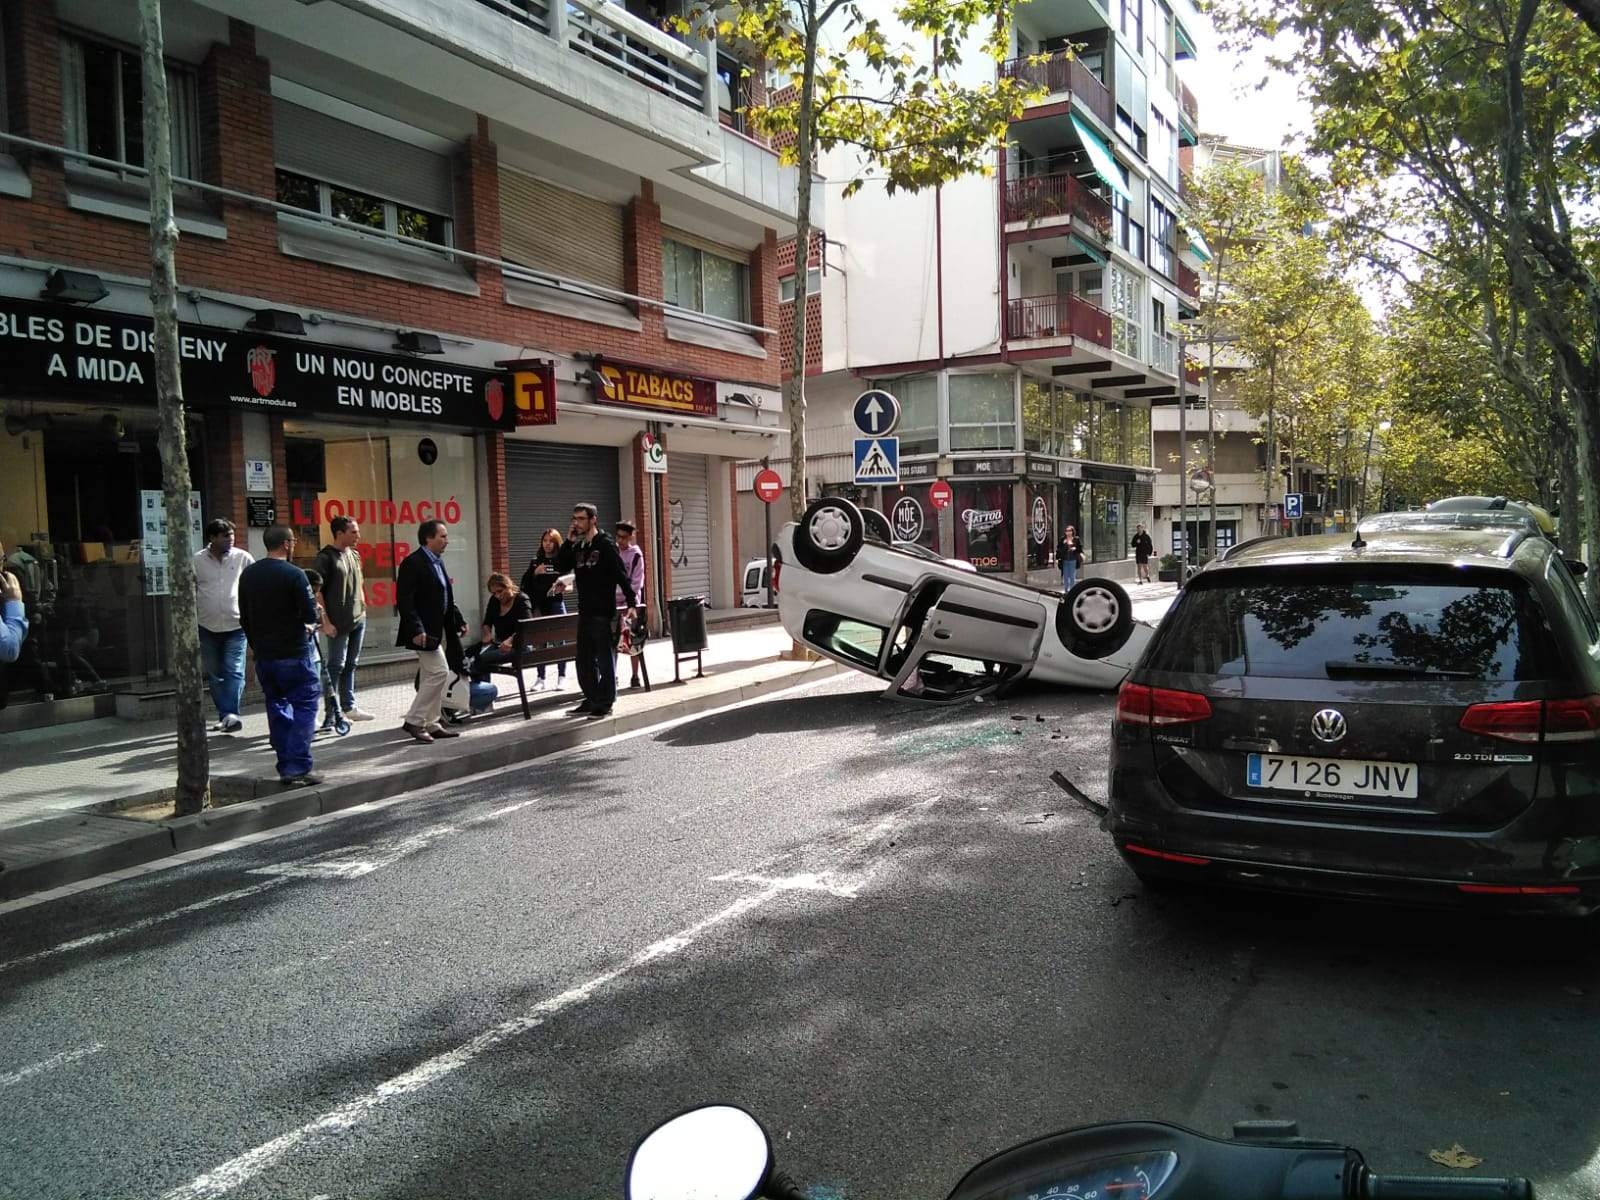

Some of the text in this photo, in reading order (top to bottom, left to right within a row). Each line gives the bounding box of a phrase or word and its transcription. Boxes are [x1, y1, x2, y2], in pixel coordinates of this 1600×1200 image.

[75, 323, 112, 348] DE
[122, 329, 227, 362] DIENY
[48, 353, 144, 384] A MIDA
[296, 352, 473, 394] UN NOU CONCEPTE
[626, 371, 694, 401] TABACS
[230, 395, 297, 407] www.artmodul.es
[337, 386, 442, 415] EN MOBLES
[976, 462, 991, 471] MOE
[292, 496, 461, 526] LIQUIDACIÓ
[898, 507, 915, 522] MOE
[1288, 497, 1298, 510] P
[357, 542, 410, 568] PER
[1268, 758, 1341, 787] 7126
[1353, 765, 1410, 792] JNV
[1047, 1186, 1059, 1195] 40
[1084, 1190, 1098, 1199] 60
